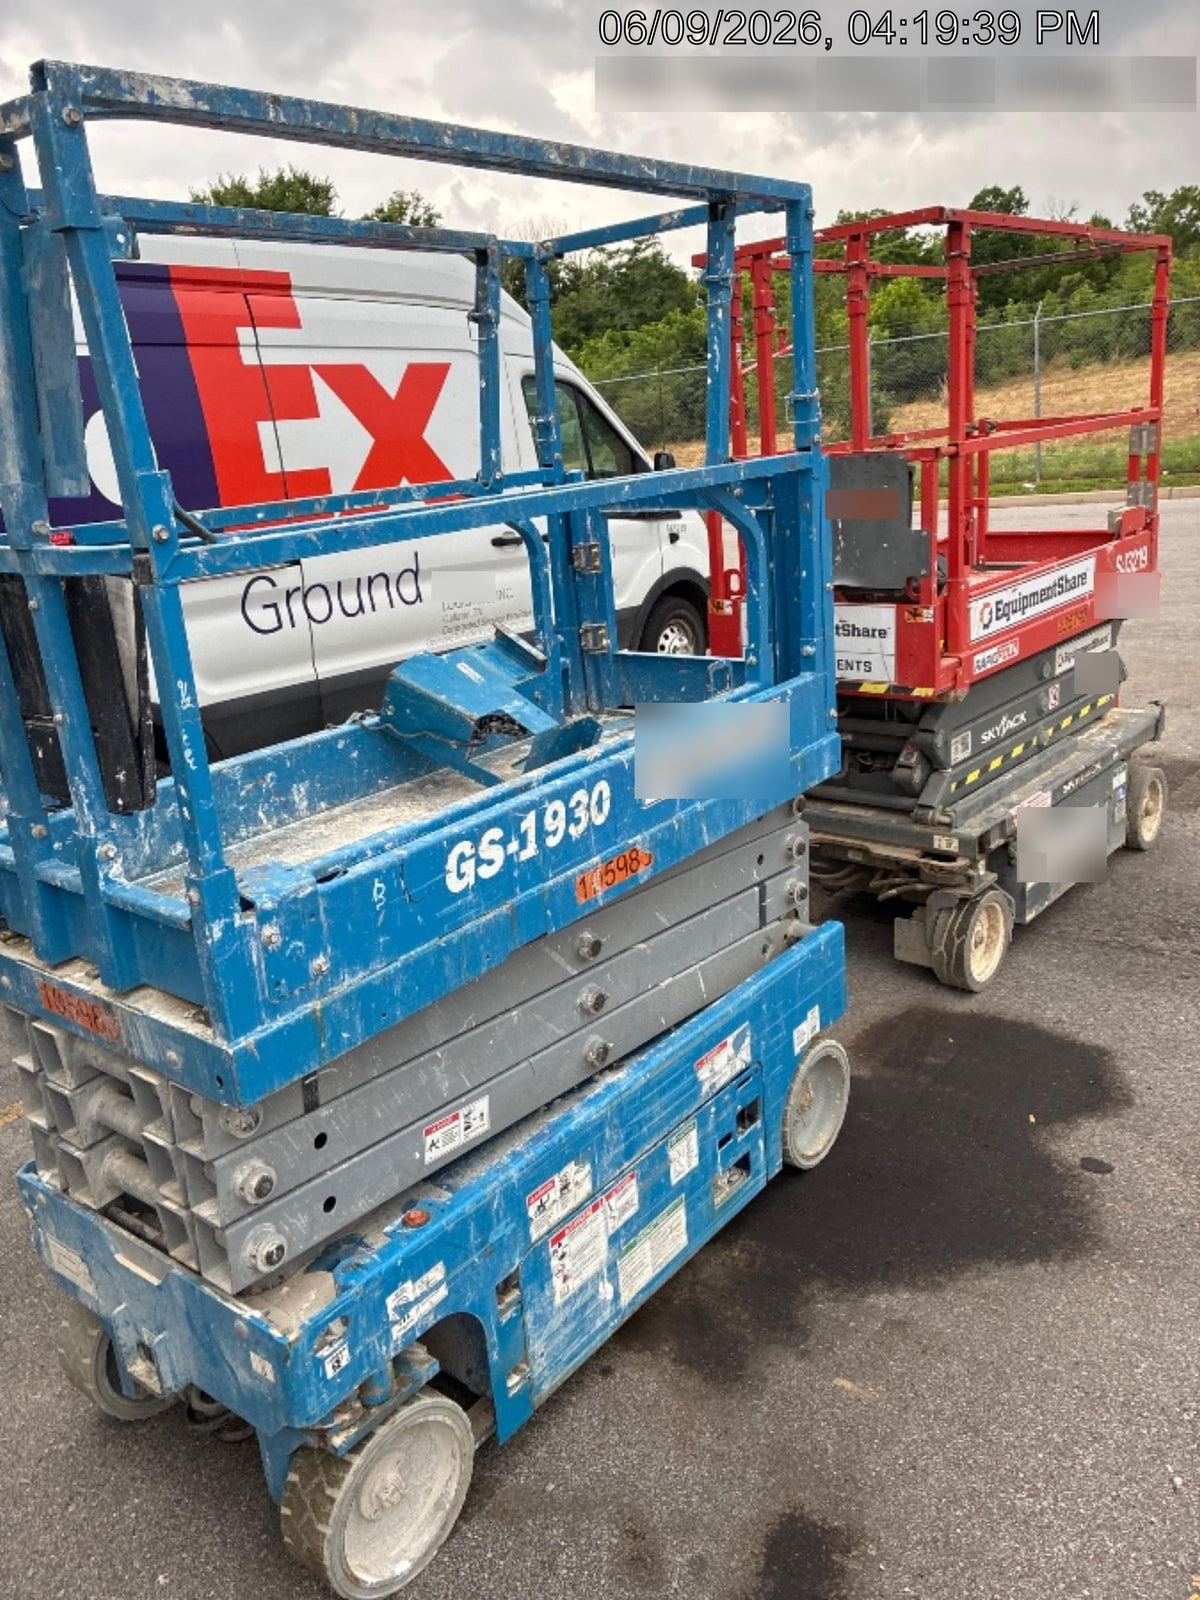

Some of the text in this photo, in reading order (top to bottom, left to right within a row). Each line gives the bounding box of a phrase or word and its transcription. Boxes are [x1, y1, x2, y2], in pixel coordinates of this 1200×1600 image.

[240, 551, 424, 635] Ground
[994, 571, 1088, 622] EquipmentShare
[980, 710, 1028, 745] SKYJACK
[445, 779, 612, 894] GS-1930
